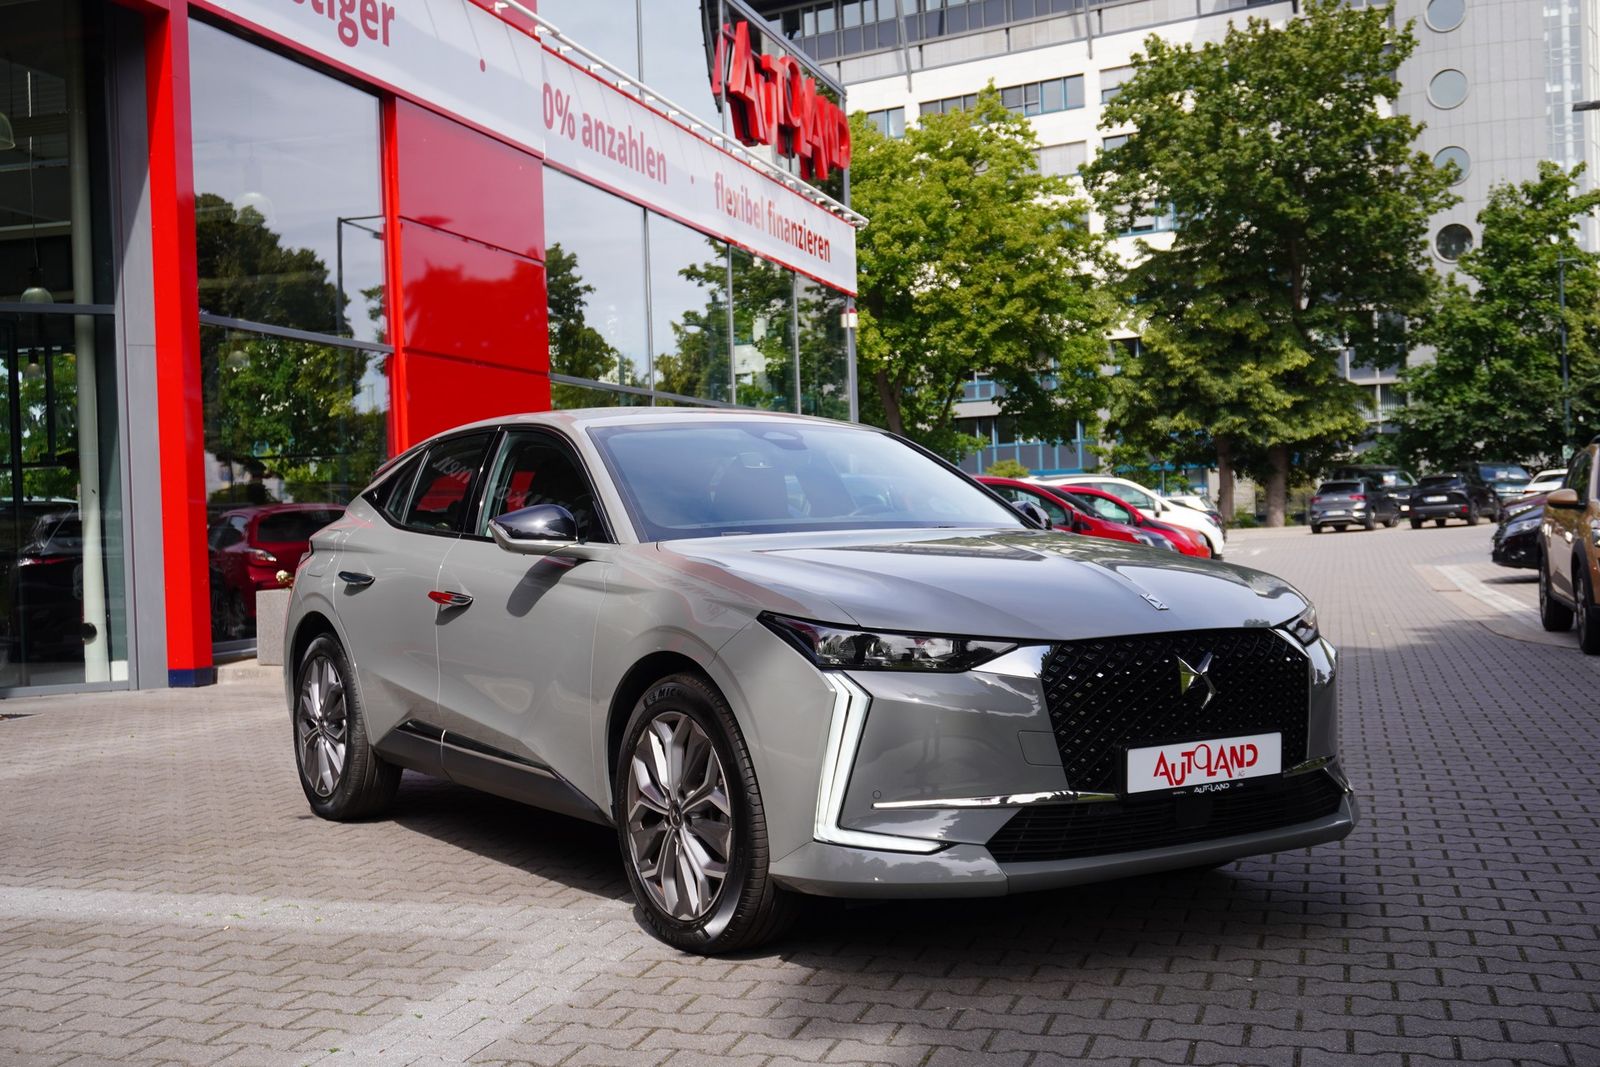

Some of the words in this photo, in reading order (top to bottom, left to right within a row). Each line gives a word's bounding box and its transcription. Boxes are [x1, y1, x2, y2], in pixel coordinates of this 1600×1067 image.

[543, 82, 576, 141] 0%
[582, 112, 667, 185] anzahlen
[714, 171, 765, 232] flexibel
[768, 200, 831, 263] finanzieren
[1153, 743, 1258, 786] AUTOLAND
